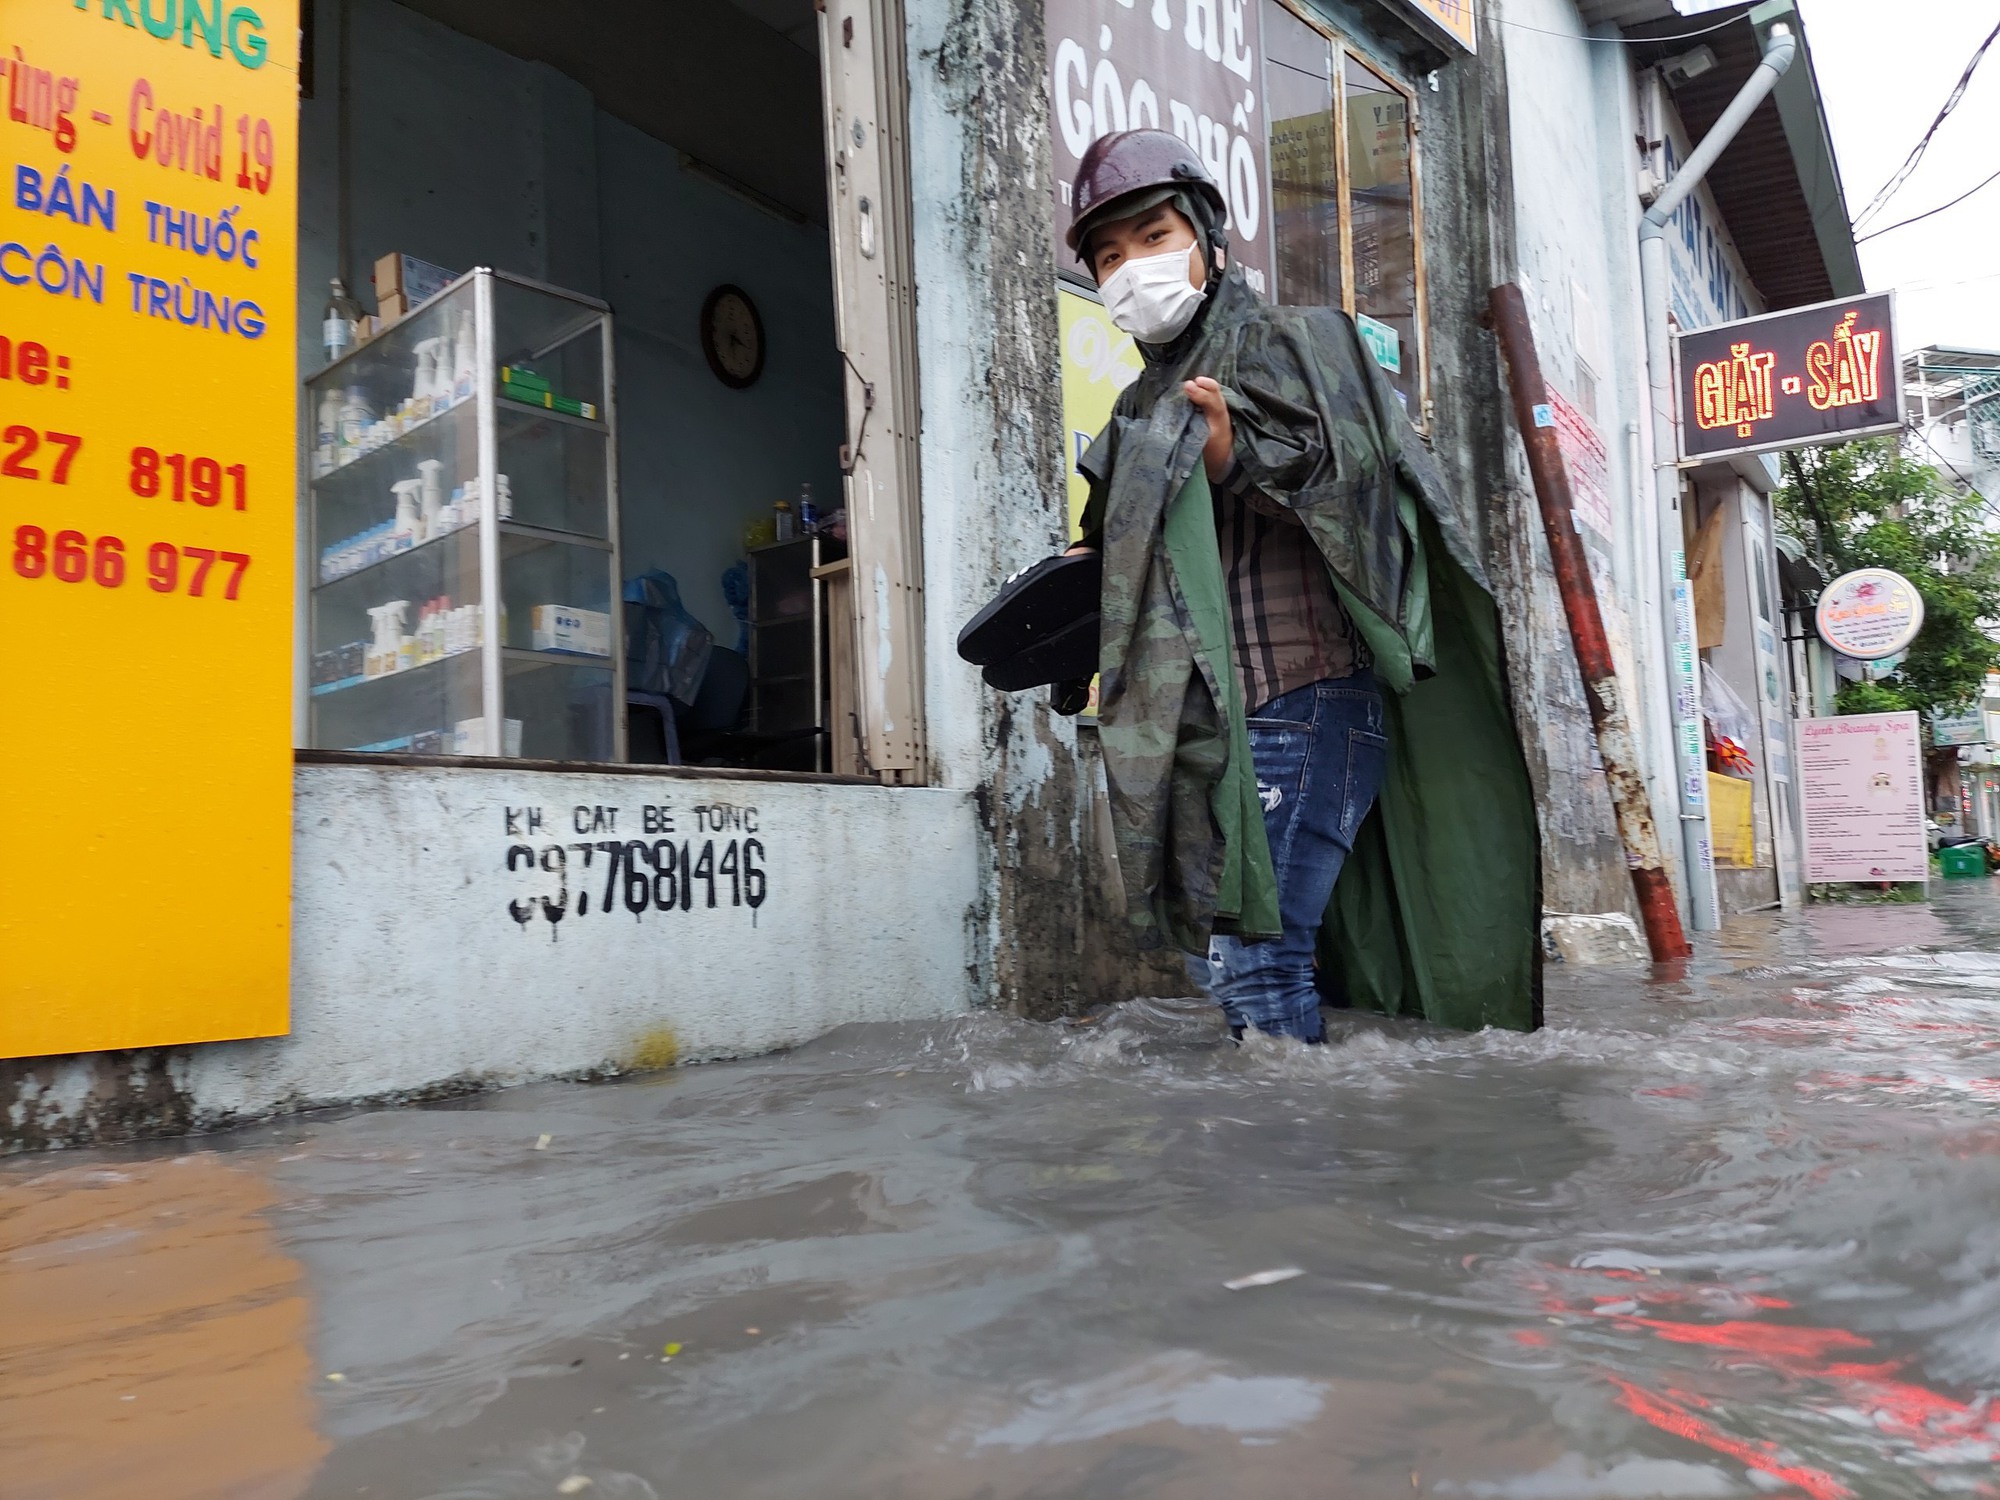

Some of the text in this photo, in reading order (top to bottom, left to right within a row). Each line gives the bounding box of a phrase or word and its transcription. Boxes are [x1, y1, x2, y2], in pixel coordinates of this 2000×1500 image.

[73, 0, 268, 70] UNG
[0, 45, 79, 154] ùng
[129, 78, 222, 181] Covid
[236, 113, 274, 195] 19
[15, 163, 259, 268] BÁN THUỐC
[0, 242, 266, 339] CÔN TRÙNG
[1694, 342, 1776, 438] GIẶT
[1, 424, 247, 511] 27 8191
[13, 525, 251, 600] 866 977
[505, 806, 542, 836] KH
[573, 805, 619, 835] CAT
[644, 804, 676, 834] BE
